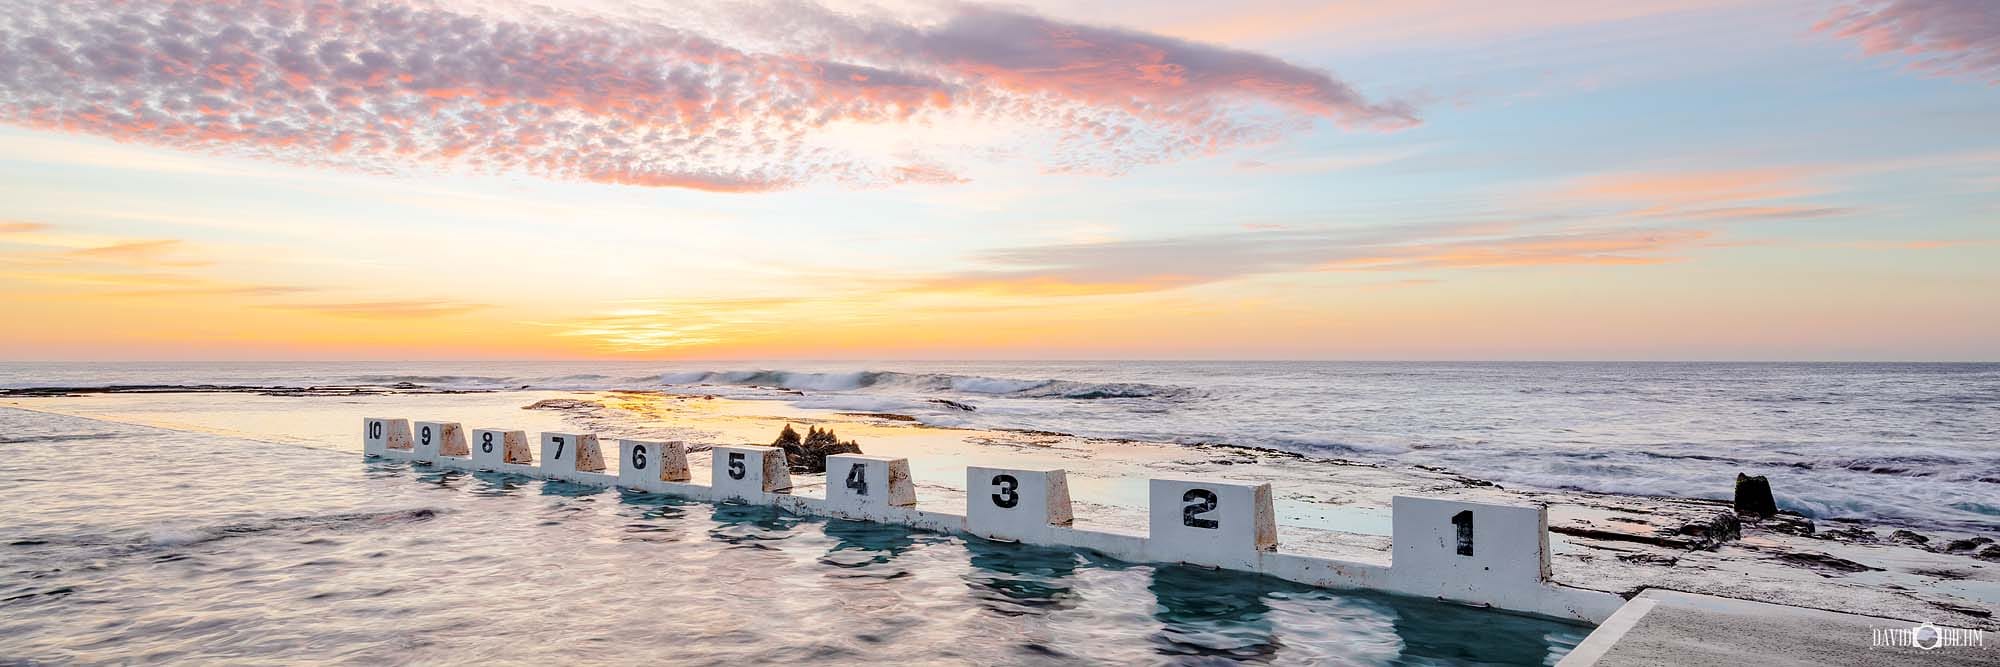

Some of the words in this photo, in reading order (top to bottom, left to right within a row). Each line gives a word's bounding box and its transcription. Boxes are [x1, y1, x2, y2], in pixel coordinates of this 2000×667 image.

[368, 421, 382, 440] 10
[421, 426, 431, 445] 9
[482, 432, 493, 453] 8
[552, 437, 565, 460] 7
[632, 445, 646, 470] 6
[728, 452, 746, 480] 5
[846, 463, 867, 495] 4
[991, 474, 1019, 508] 3
[1182, 488, 1219, 530] 2
[1451, 509, 1474, 557] 1
